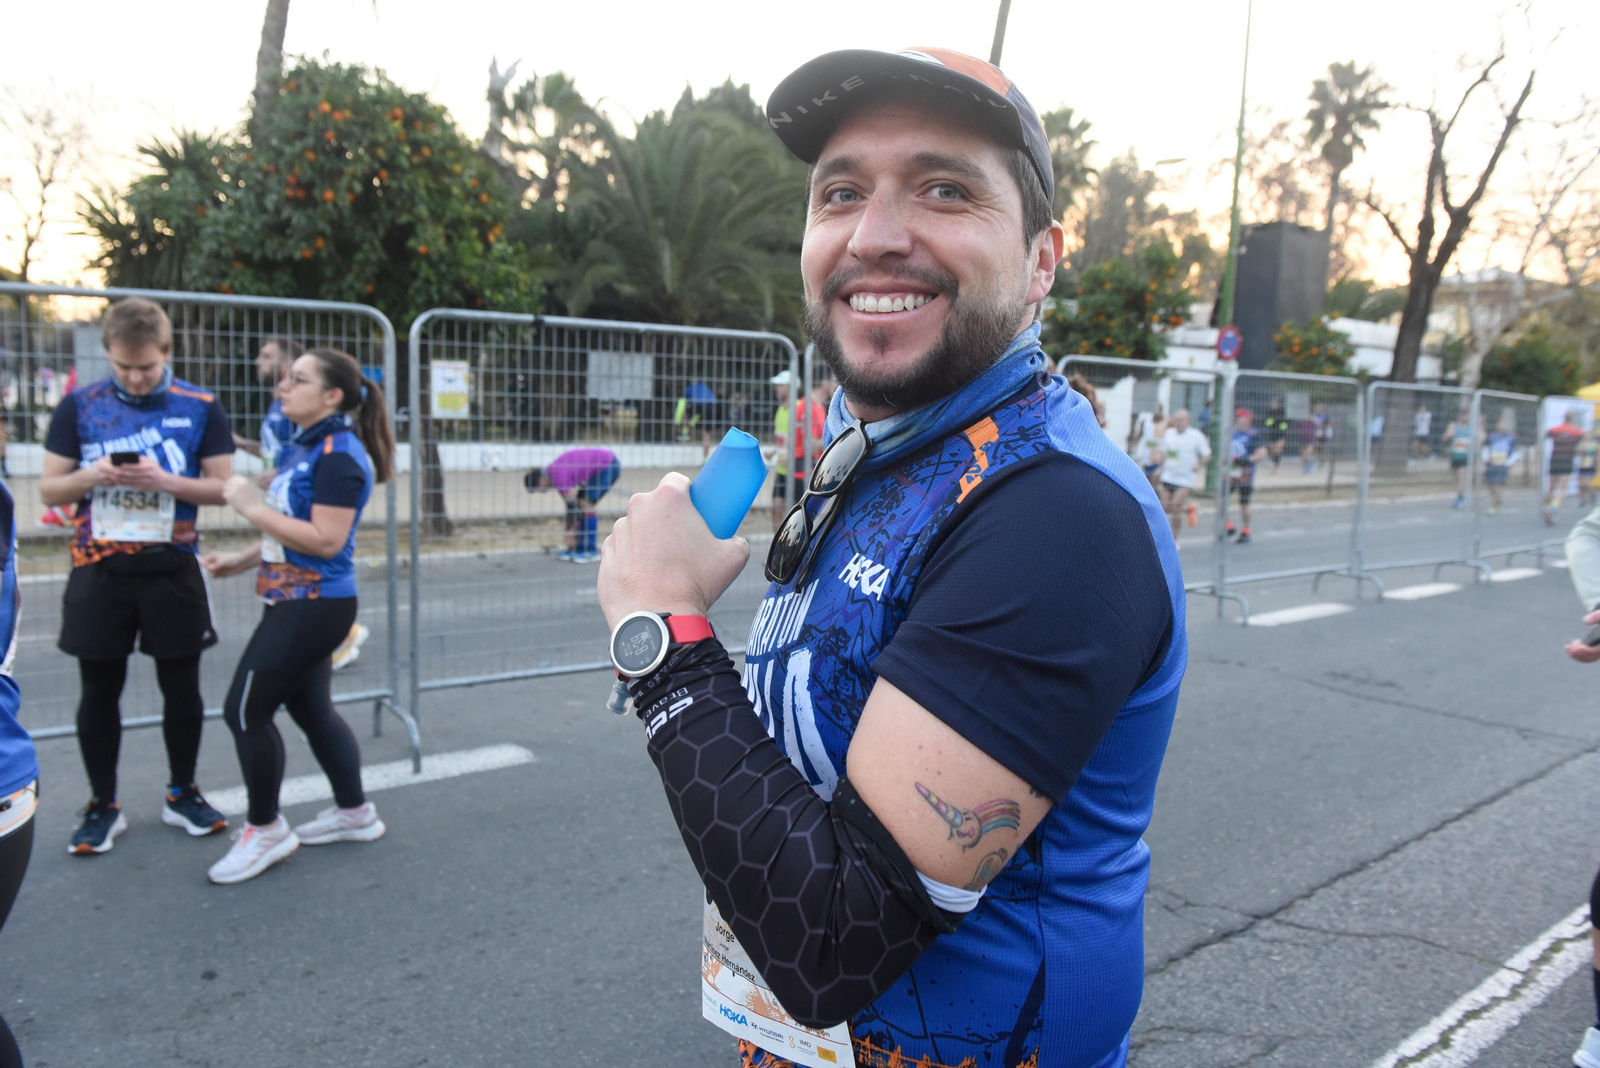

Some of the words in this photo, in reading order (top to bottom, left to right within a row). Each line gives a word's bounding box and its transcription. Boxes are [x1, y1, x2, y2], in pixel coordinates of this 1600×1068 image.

[769, 75, 865, 129] NIKE
[99, 489, 160, 511] 14534
[838, 552, 890, 601] HOKA
[715, 922, 735, 943] Jorge
[719, 1003, 748, 1027] HOKA
